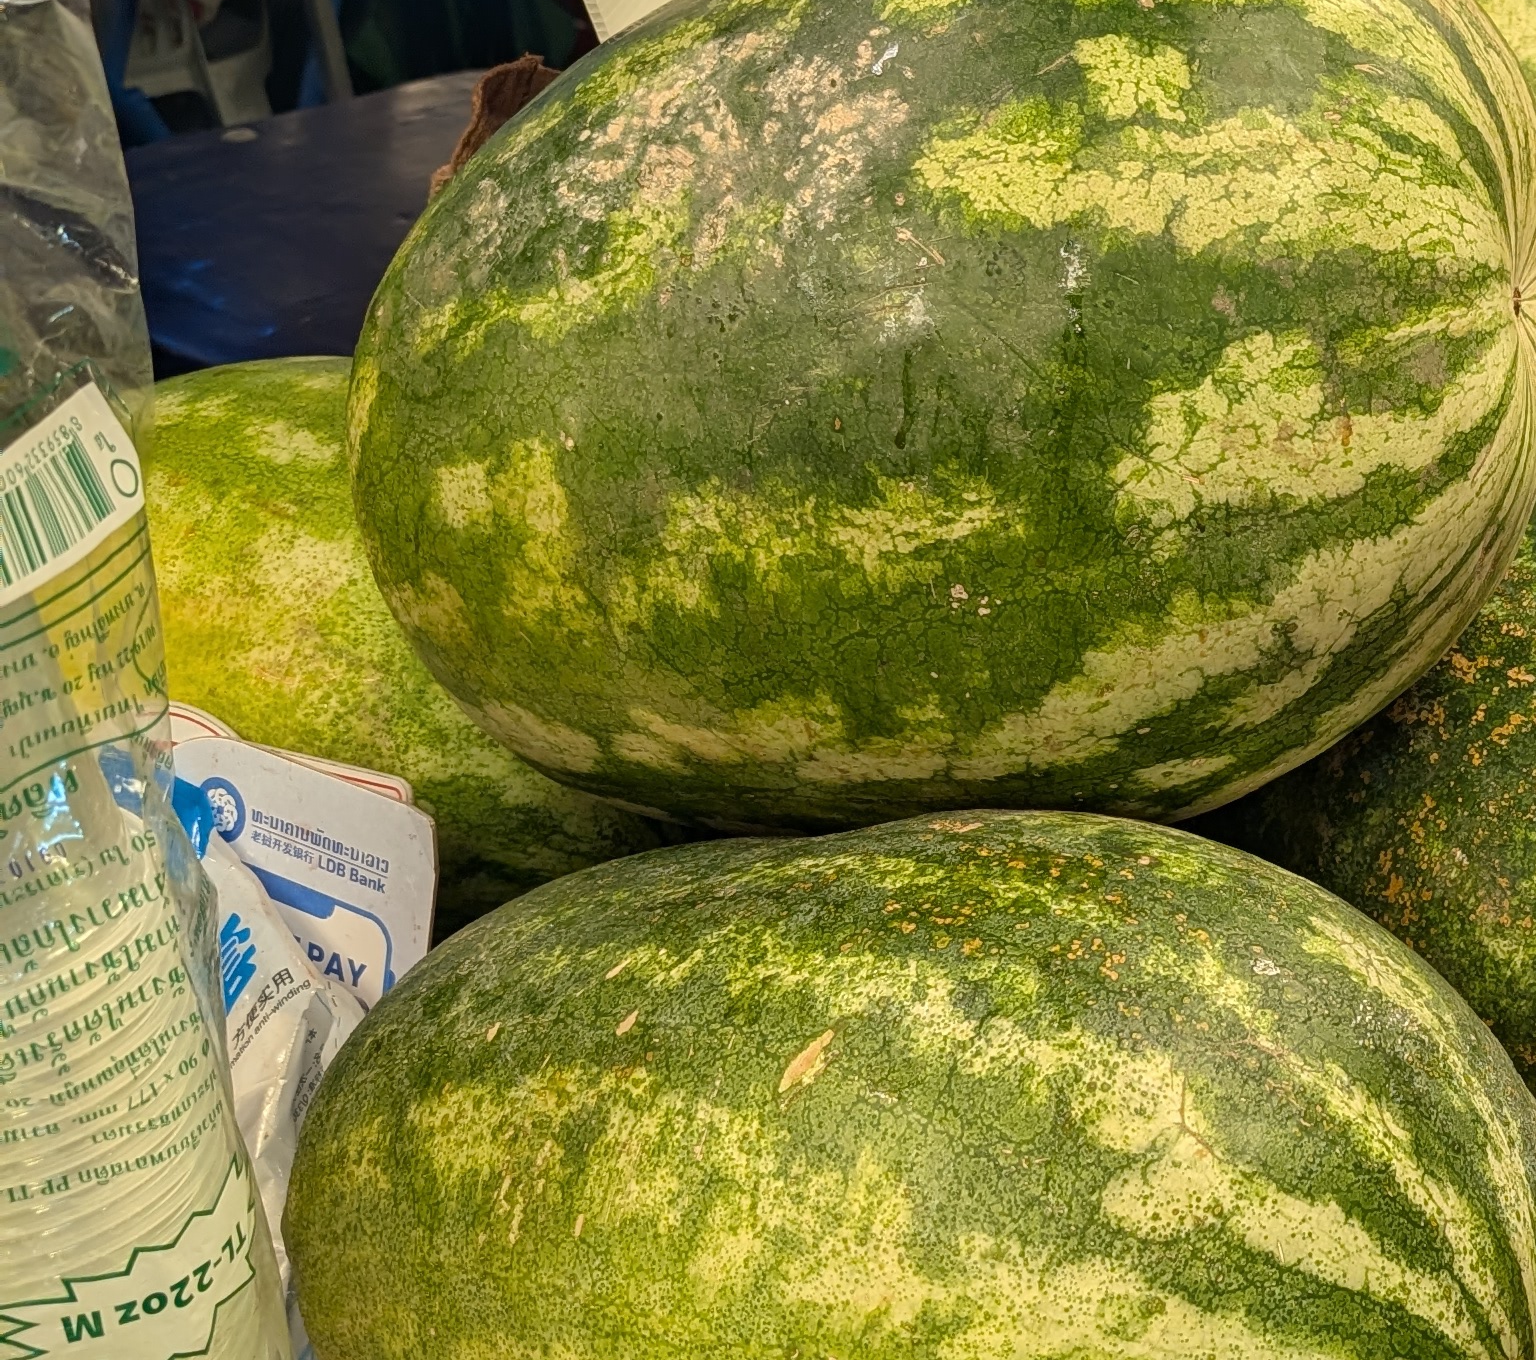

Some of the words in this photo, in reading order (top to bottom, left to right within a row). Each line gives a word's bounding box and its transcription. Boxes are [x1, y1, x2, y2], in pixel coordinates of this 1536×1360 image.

[0, 652, 37, 680] บาง
[131, 828, 157, 853] 50
[317, 853, 346, 878] LDB
[349, 866, 387, 894] Bank
[0, 869, 171, 974] ห้ามวางใกล้เ
[293, 933, 368, 989] PAY
[254, 978, 312, 1037] anti-winding
[178, 1055, 199, 1077] 90
[128, 1082, 159, 1113] 177
[0, 1122, 60, 1145] ความ
[113, 1220, 248, 1326] TL-22oz
[60, 1309, 106, 1344] M
